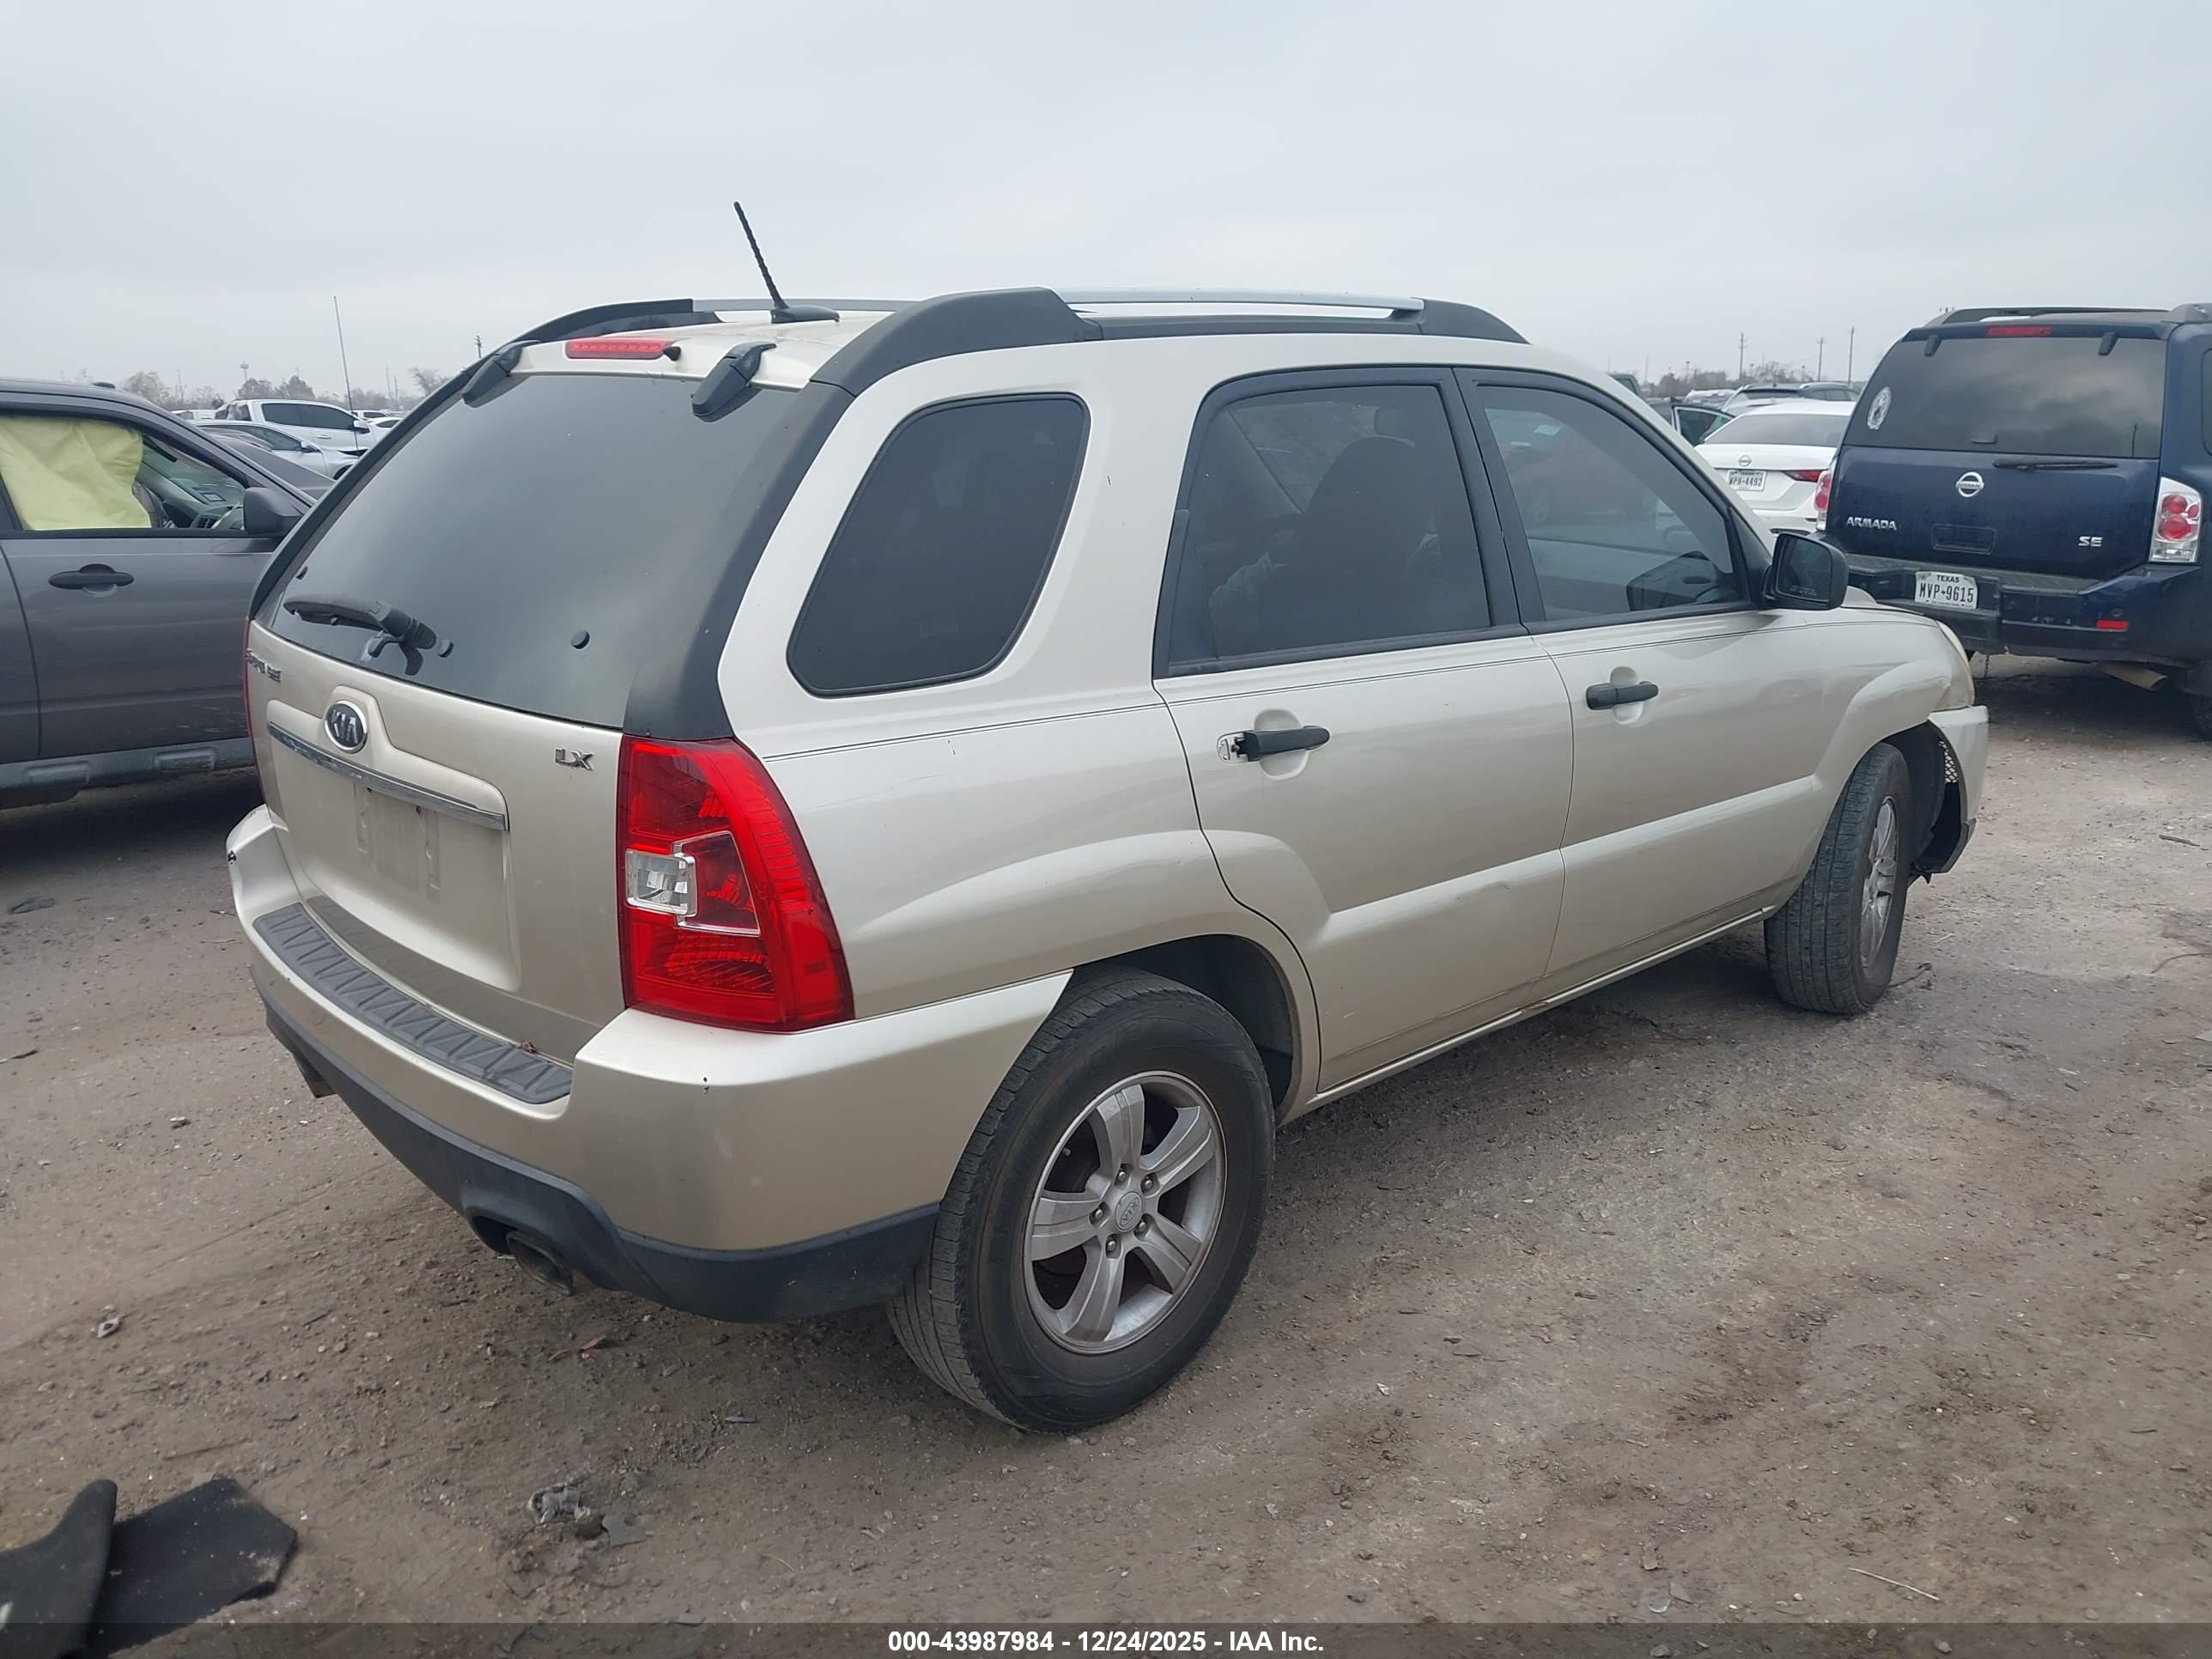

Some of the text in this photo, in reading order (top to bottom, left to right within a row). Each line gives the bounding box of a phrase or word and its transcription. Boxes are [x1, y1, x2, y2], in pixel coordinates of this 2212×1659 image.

[1845, 516, 1897, 531] ARMADA
[2077, 535, 2103, 547] SE
[1936, 574, 1960, 583] TEXAS
[330, 708, 358, 744] KIA
[555, 746, 593, 771] LX
